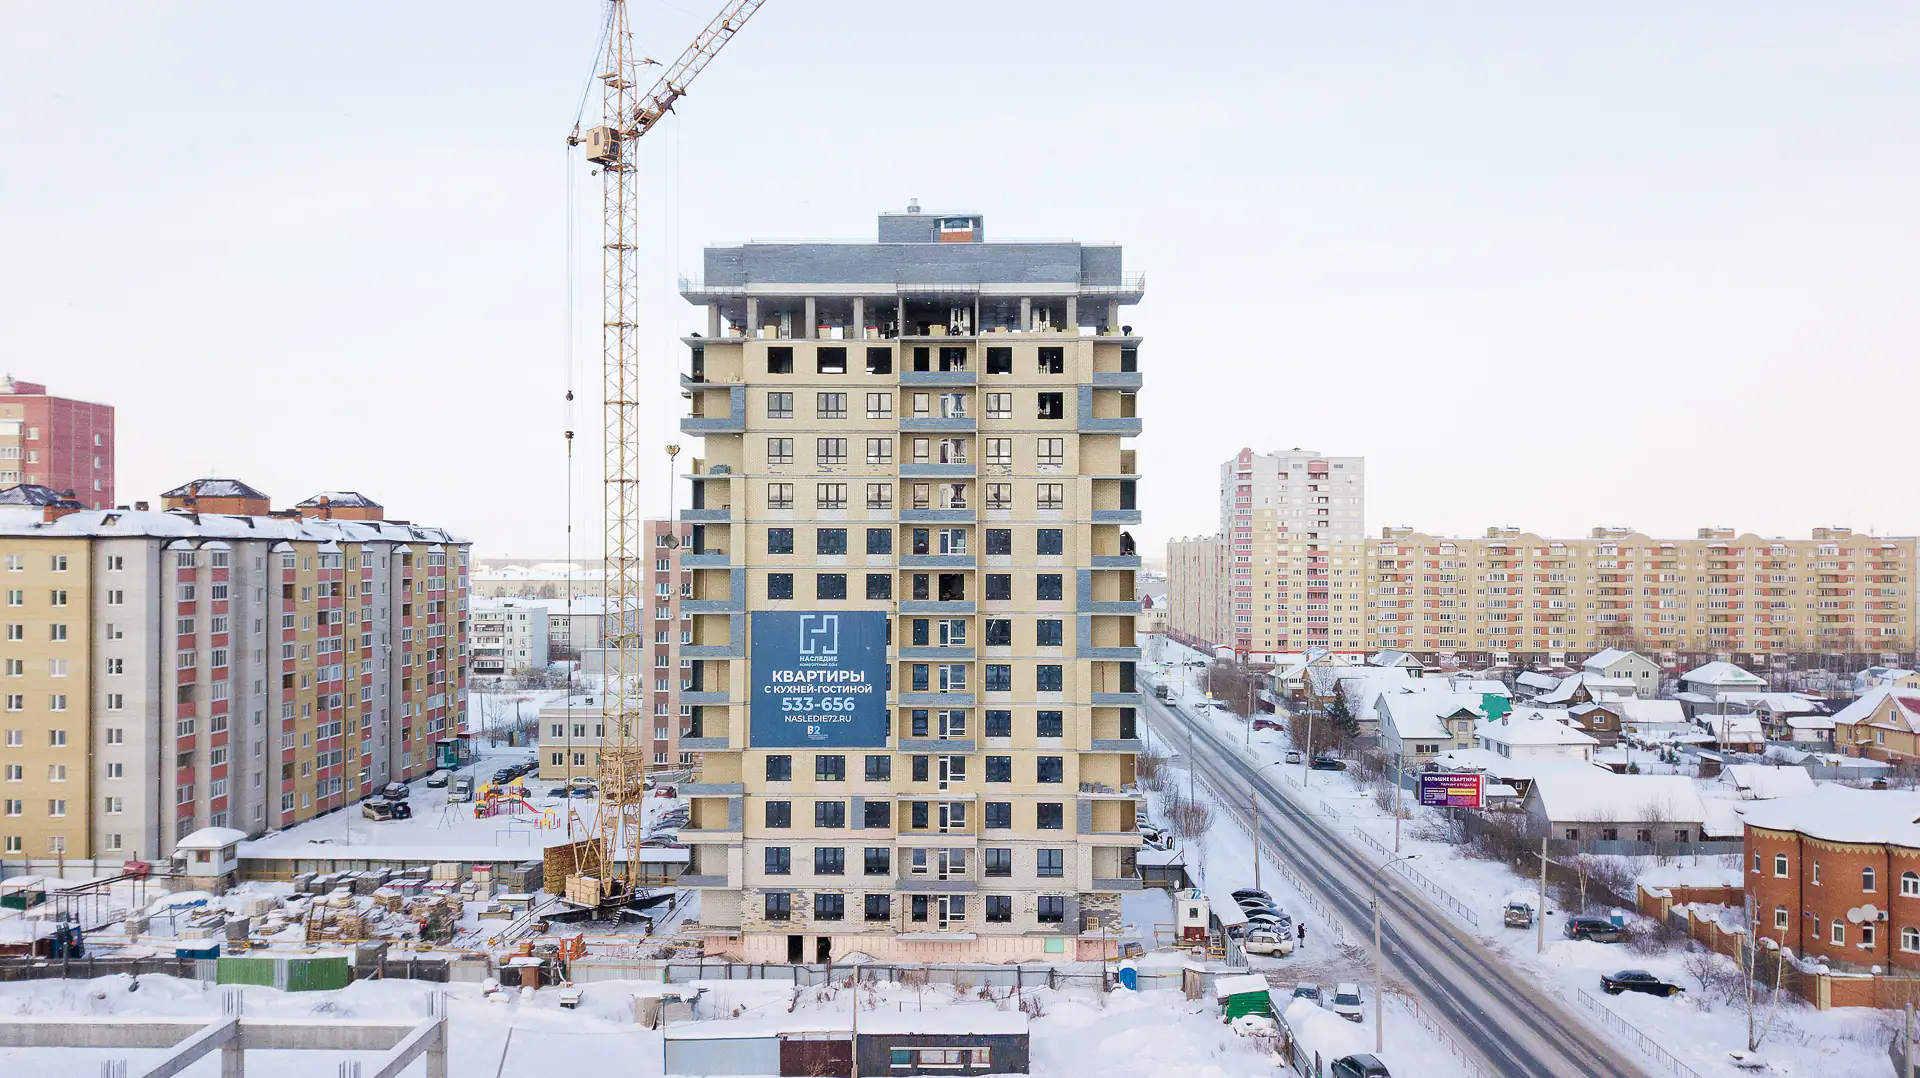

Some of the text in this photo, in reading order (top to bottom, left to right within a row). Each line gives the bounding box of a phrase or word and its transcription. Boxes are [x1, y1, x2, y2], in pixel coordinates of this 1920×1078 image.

[772, 670, 865, 683] КВАРТИРЫ
[764, 684, 873, 694] С КУХНЕЙ-ГОСТИНОЙ
[781, 697, 855, 712] 533-656
[784, 715, 852, 723] NASLEDIE72.RU
